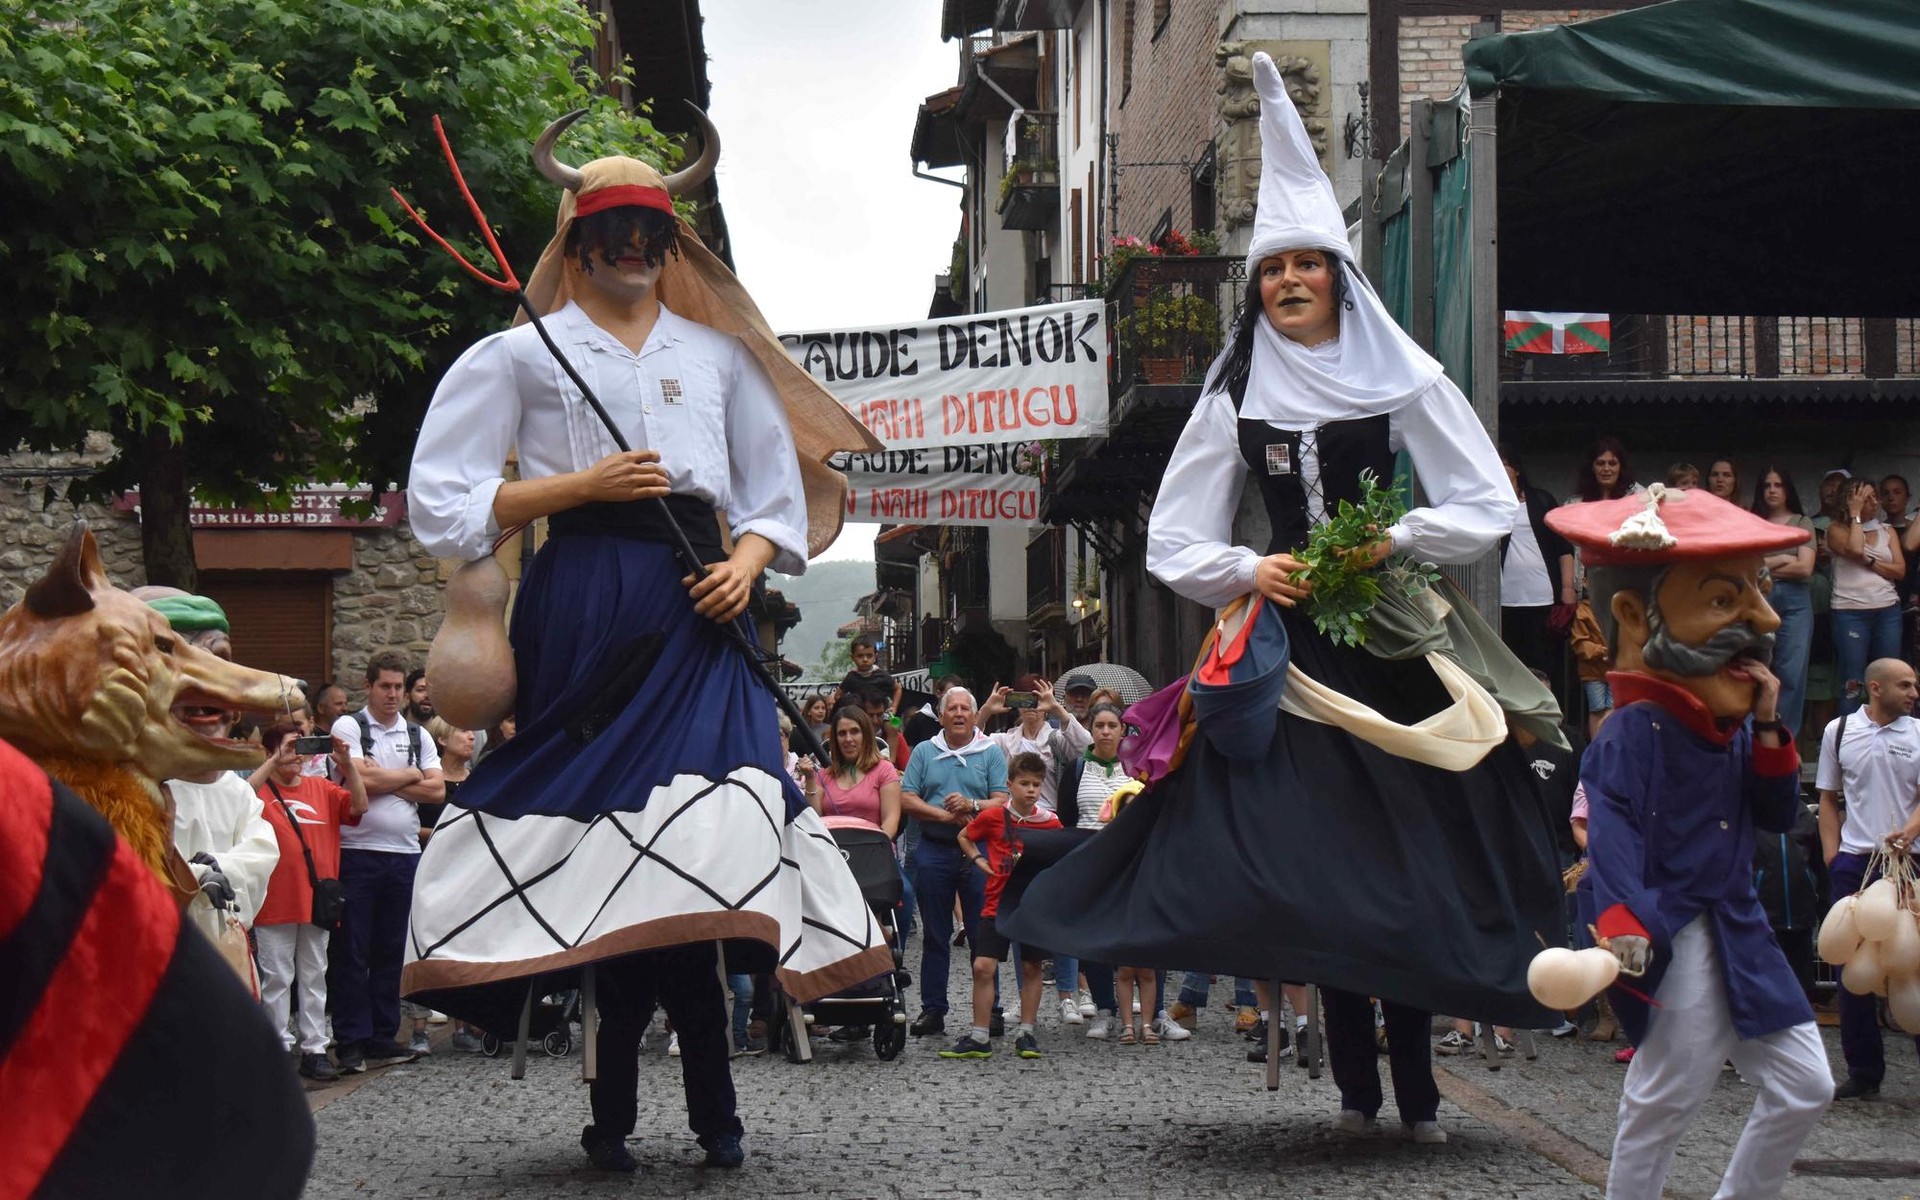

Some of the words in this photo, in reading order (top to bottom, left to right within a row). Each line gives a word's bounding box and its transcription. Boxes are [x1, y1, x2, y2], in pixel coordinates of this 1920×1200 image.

[937, 312, 1099, 371] DENOK
[942, 384, 1078, 436] DITUGU
[871, 488, 928, 518] NAHI
[941, 489, 1036, 520] DITUGU
